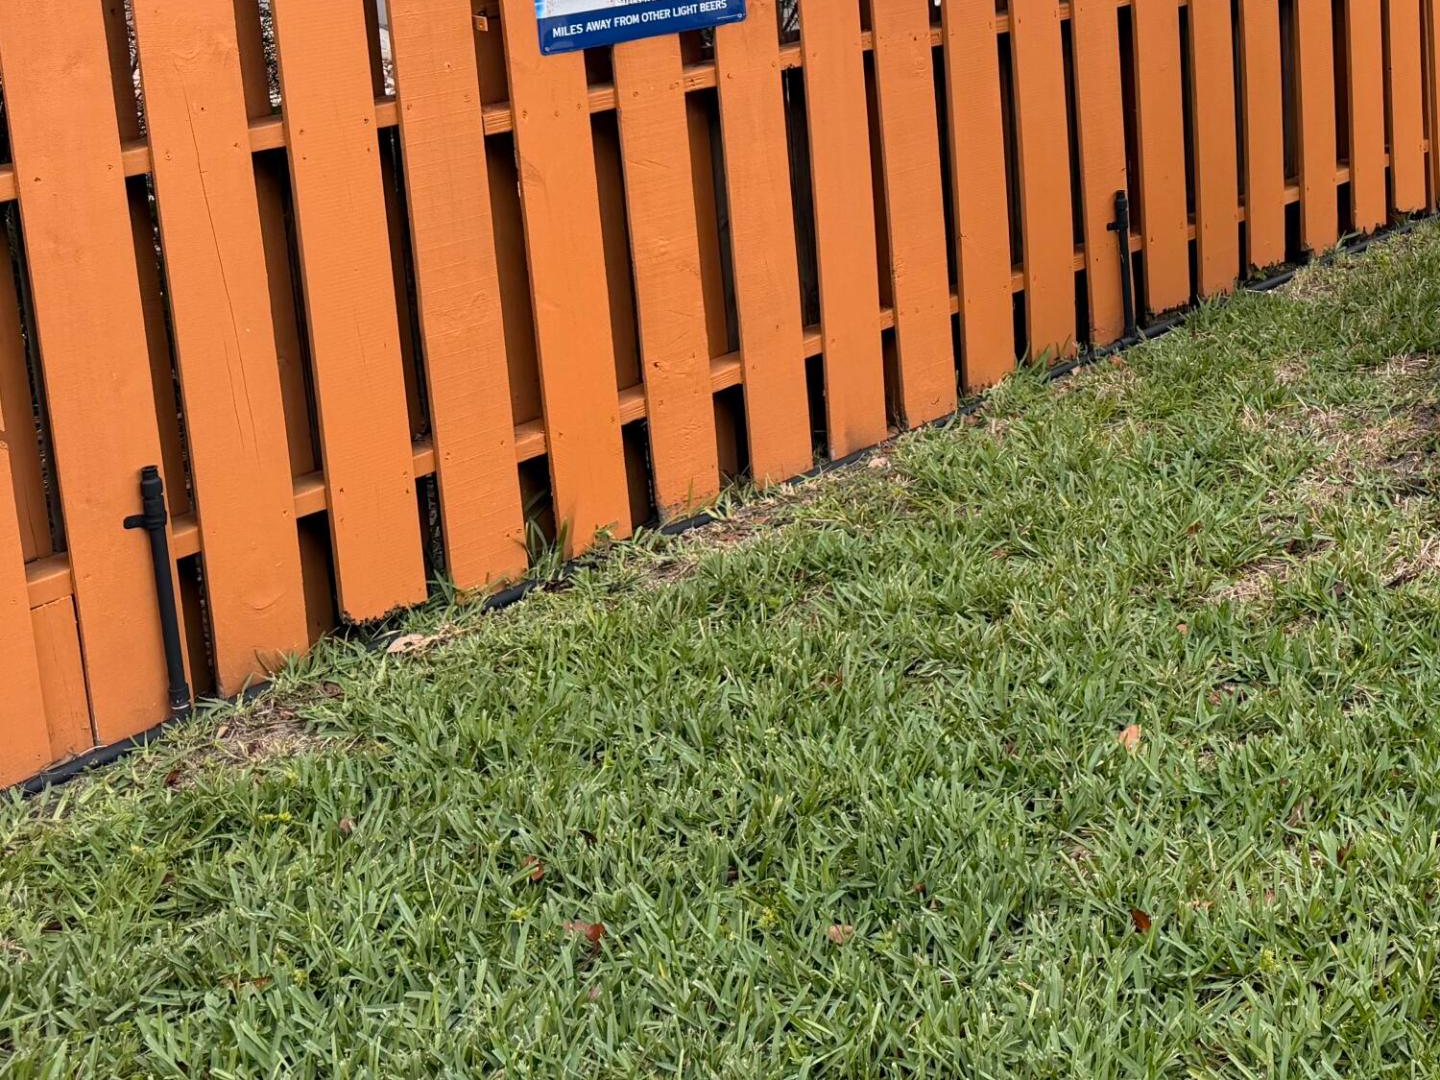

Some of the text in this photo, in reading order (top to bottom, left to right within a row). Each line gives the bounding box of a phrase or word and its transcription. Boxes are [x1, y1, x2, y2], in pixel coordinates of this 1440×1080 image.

[552, 0, 728, 38] MILES AWAY FROM OTHER LIGHT BEERS
